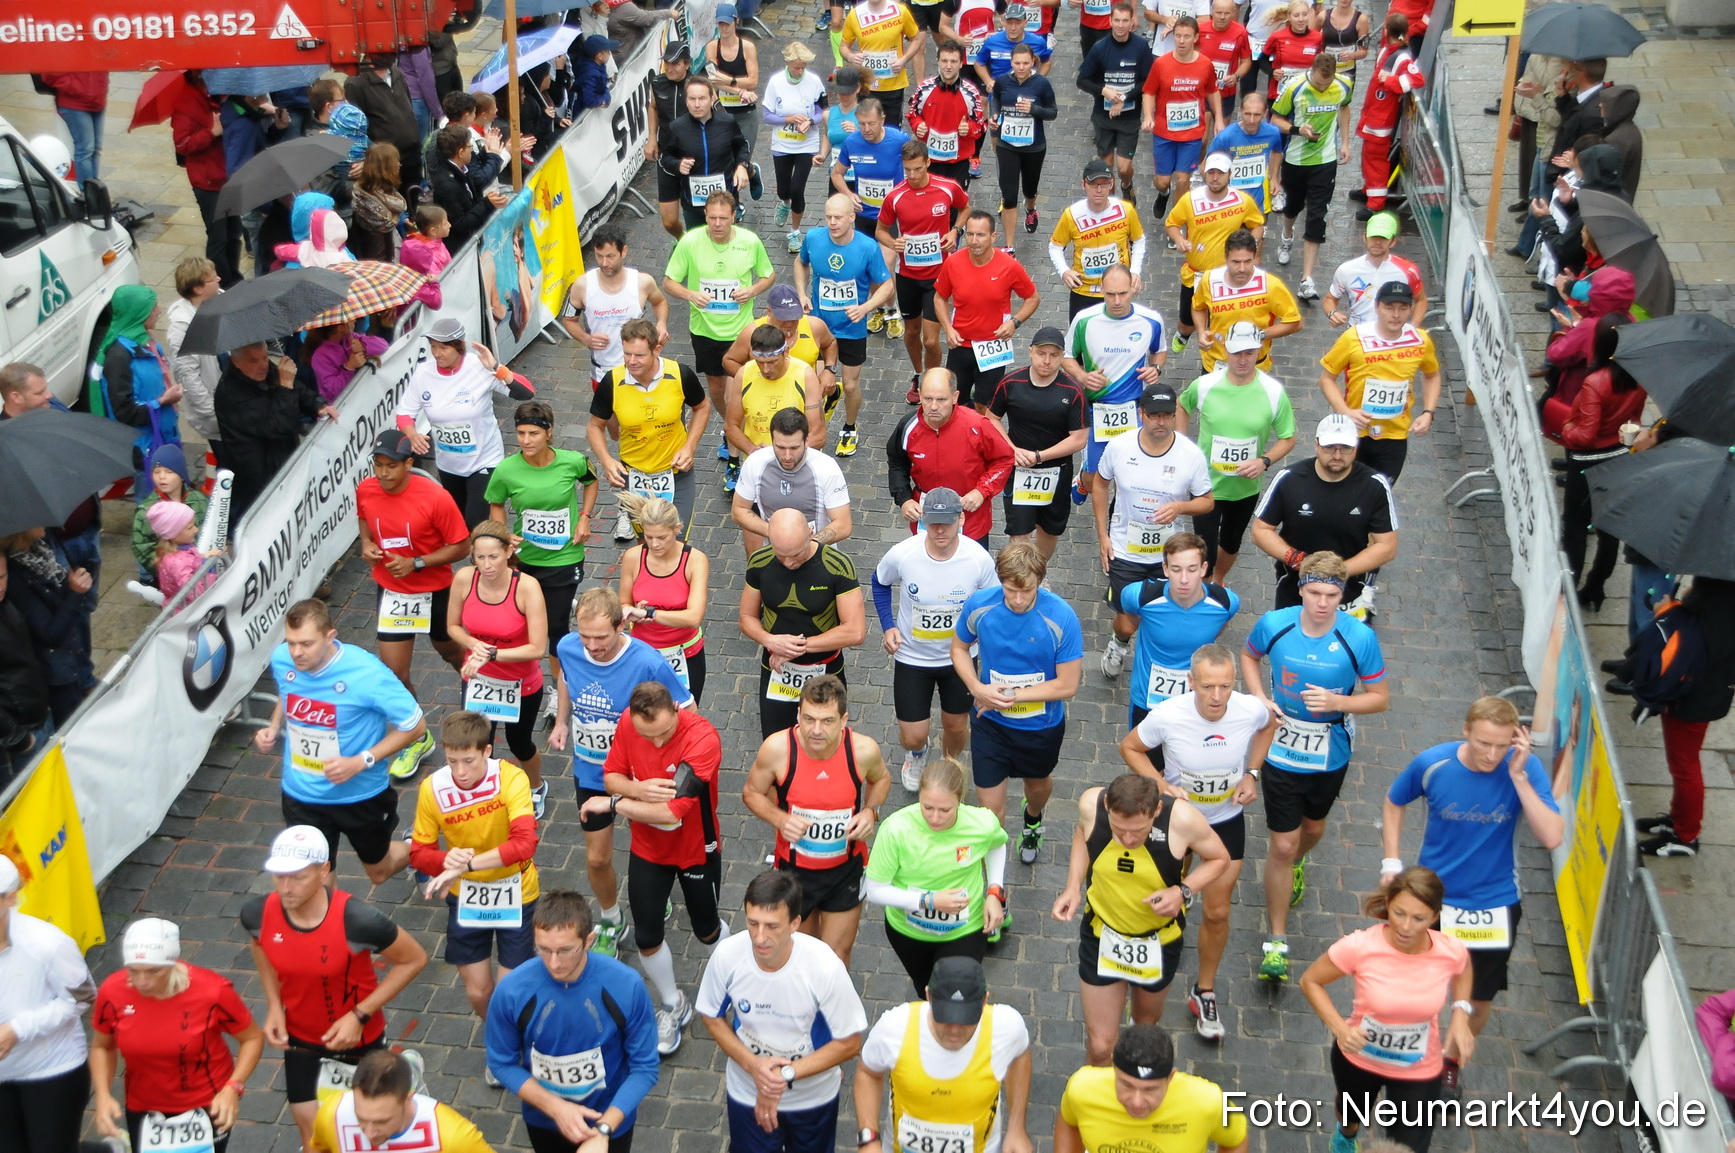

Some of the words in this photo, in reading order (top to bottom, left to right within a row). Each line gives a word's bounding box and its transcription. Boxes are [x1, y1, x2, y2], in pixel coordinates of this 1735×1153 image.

[0, 17, 83, 43] eline:
[93, 15, 175, 40] 09181
[184, 13, 256, 36] 6352
[862, 27, 879, 37] MAX
[882, 20, 902, 31] BÖGL
[864, 58, 888, 69] 2883
[1170, 109, 1196, 121] 2343
[1004, 124, 1030, 136] 3177
[930, 138, 955, 151] 2138
[1234, 164, 1262, 178] 2010
[865, 186, 886, 198] 554
[1196, 215, 1218, 226] MAX
[1220, 208, 1246, 219] BÖGL
[1080, 230, 1102, 242] MAX
[1104, 221, 1128, 234] BÖGL
[907, 241, 938, 255] 2555
[1085, 252, 1116, 268] 2852
[823, 285, 854, 298] 2115
[1212, 302, 1235, 314] MAX
[1239, 298, 1268, 310] BÖGL
[978, 340, 1009, 358] 2631
[1365, 354, 1394, 364] MAX
[1397, 348, 1425, 359] BÖGL
[1368, 388, 1403, 404] 2914
[1102, 412, 1128, 426] 428
[436, 430, 470, 444] 2389
[1220, 448, 1248, 462] 456
[1023, 476, 1051, 491] 470
[528, 520, 566, 536] 2338
[532, 536, 559, 545] Cornelia
[1142, 532, 1160, 545] 88
[240, 520, 291, 617] BMW
[390, 600, 420, 616] 214
[922, 614, 953, 629] 528
[472, 683, 516, 704] 2216
[286, 696, 336, 725] Lete
[484, 706, 501, 714] Julia
[1277, 726, 1324, 752] 2717
[300, 739, 320, 758] 37
[1285, 750, 1310, 762] Adrian
[1193, 779, 1229, 794] 314
[444, 811, 474, 825] MAX
[479, 799, 506, 816] BÖGL
[39, 824, 67, 869] KAN
[467, 886, 513, 906] 2871
[477, 910, 502, 920] Jonas
[1455, 930, 1493, 940] Christian
[1112, 944, 1148, 964] 438
[1366, 1029, 1421, 1050] 3042
[539, 1062, 598, 1084] 3133
[906, 1132, 965, 1153] 2873
